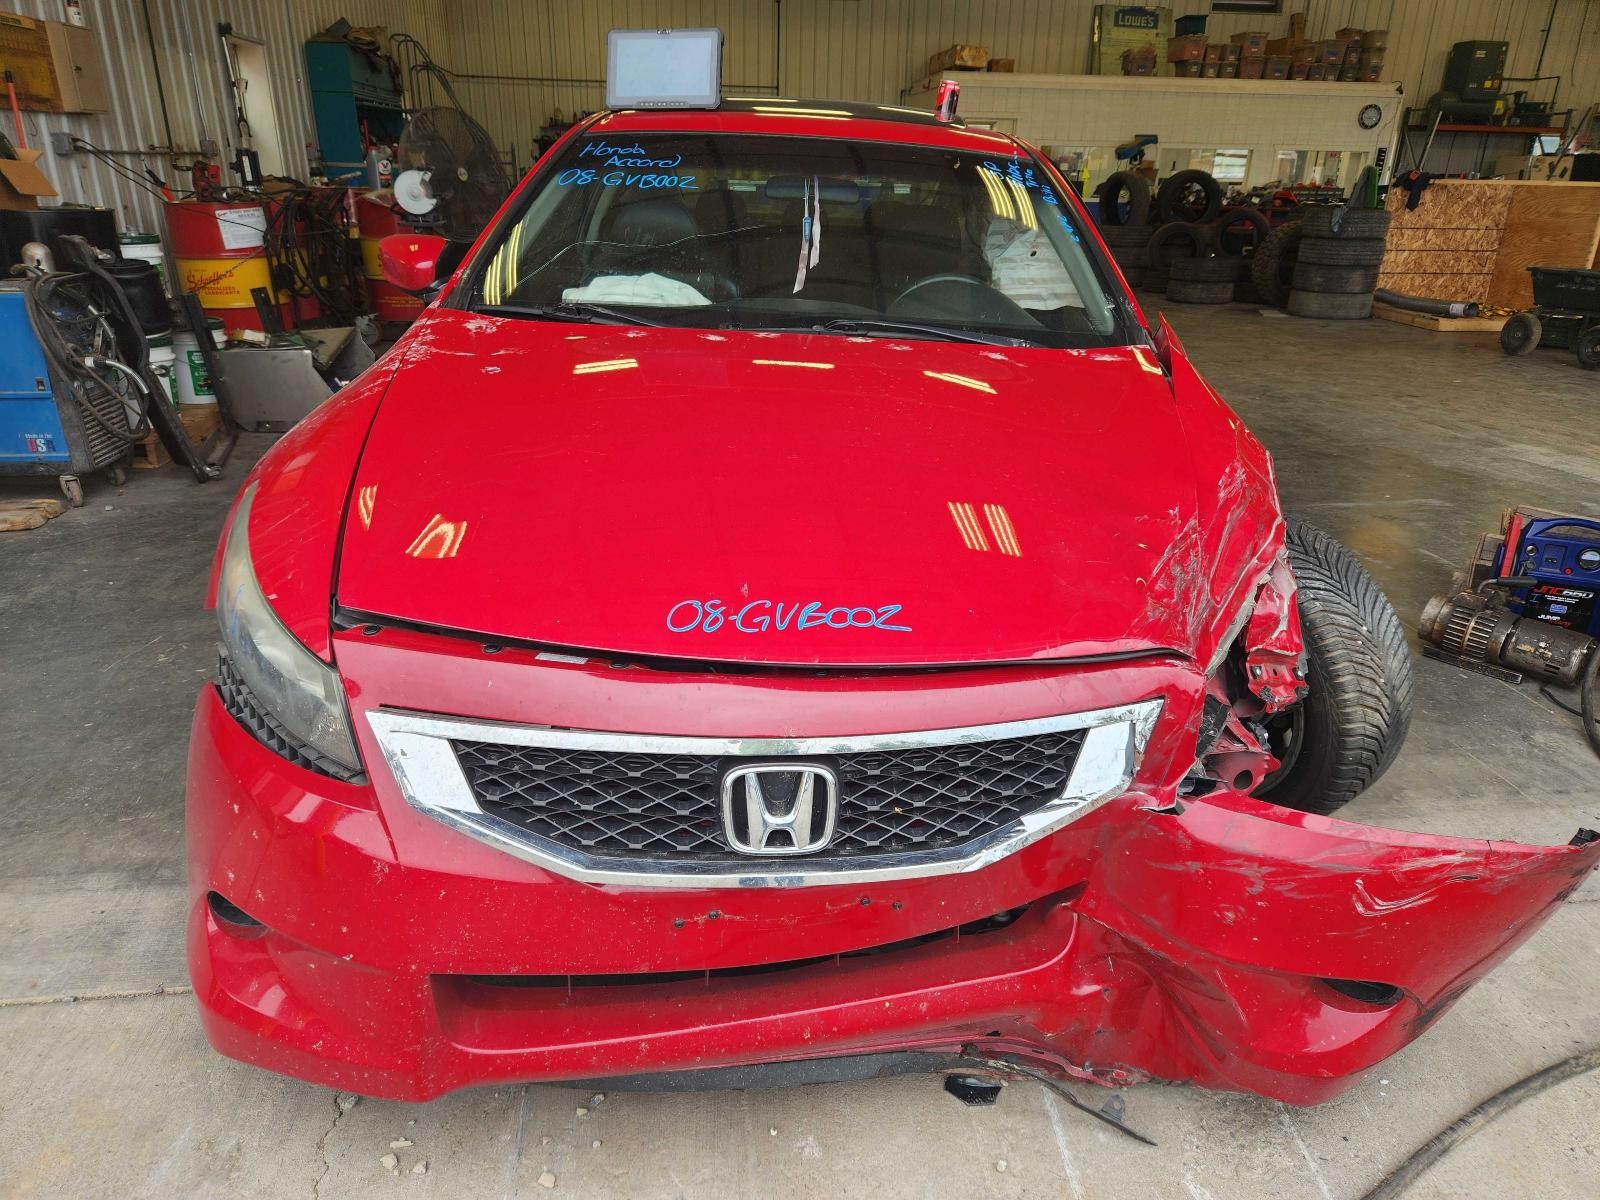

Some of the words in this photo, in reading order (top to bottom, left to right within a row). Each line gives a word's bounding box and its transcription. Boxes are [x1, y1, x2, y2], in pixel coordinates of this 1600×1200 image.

[1118, 13, 1156, 28] LOWE'S
[579, 141, 647, 157] Honda
[603, 154, 682, 169] Accord
[558, 168, 700, 189] 08-GVB002
[27, 438, 57, 453] USA
[666, 599, 913, 634] 08-GVB002
